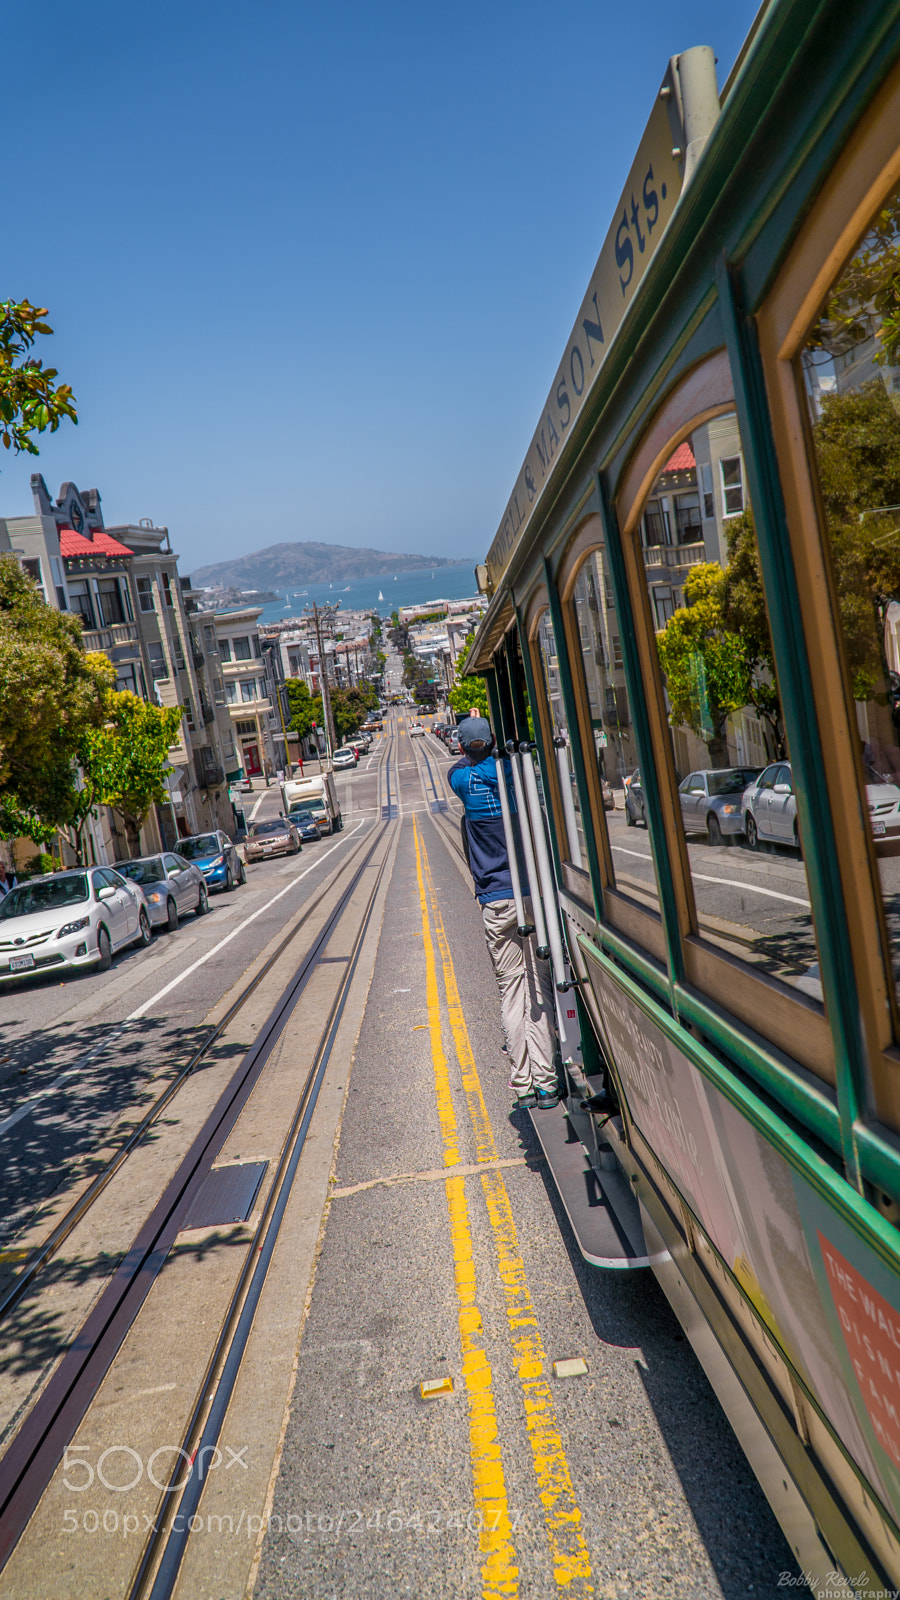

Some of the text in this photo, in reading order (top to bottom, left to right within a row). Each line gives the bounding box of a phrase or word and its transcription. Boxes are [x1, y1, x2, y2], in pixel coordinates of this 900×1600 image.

[491, 162, 667, 578] POWELL & MASON Sts.
[825, 1252, 900, 1348] THE WAL
